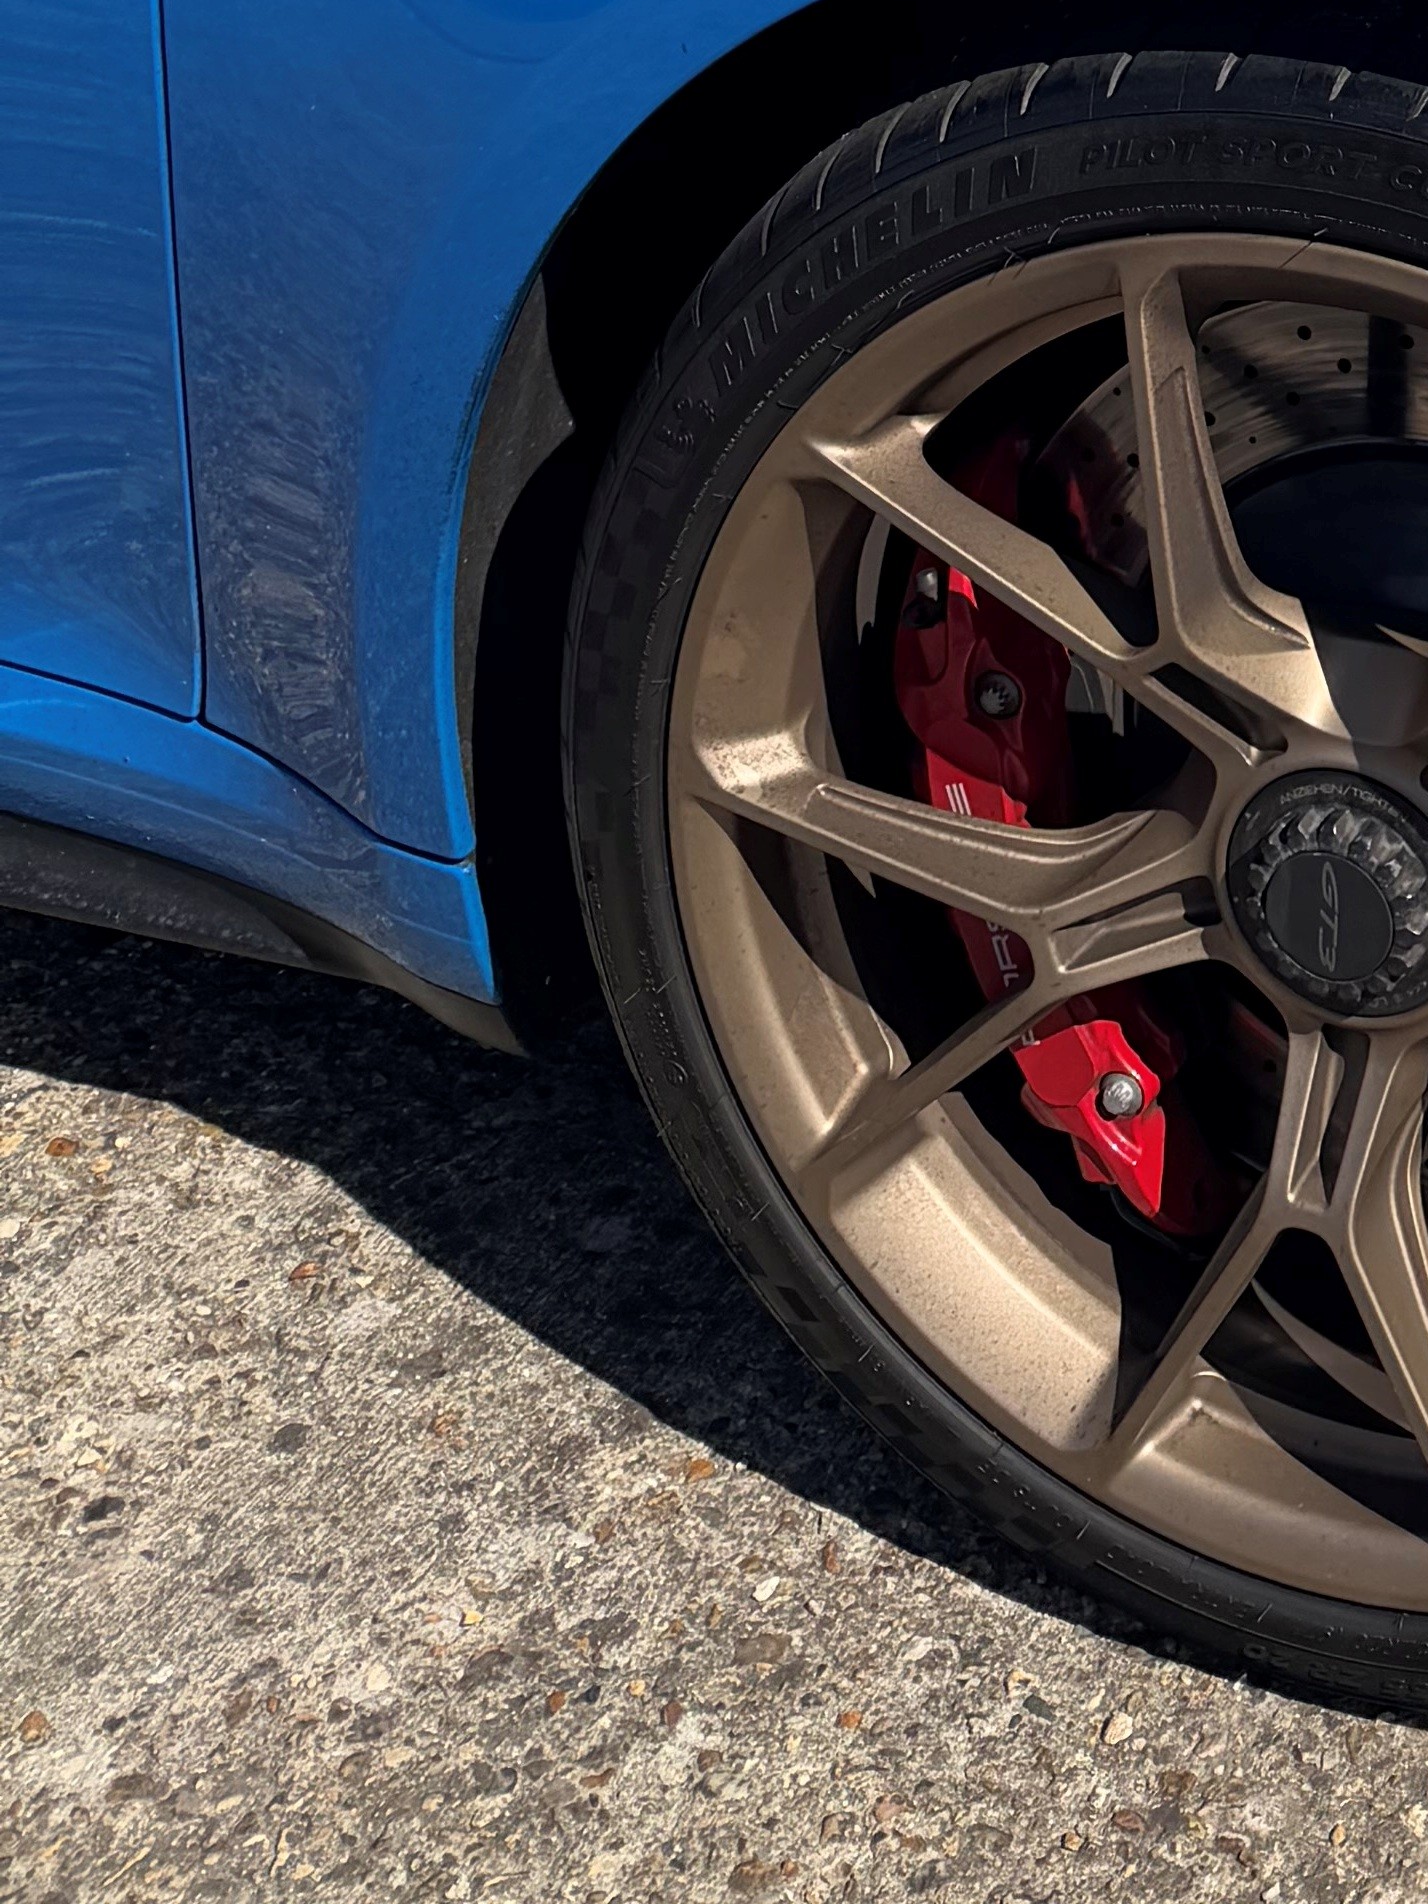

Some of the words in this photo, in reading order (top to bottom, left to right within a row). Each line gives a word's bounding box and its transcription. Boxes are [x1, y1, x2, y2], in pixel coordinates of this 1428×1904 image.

[1079, 135, 1208, 175] PILOT
[1219, 135, 1378, 180] SPORT
[709, 145, 1038, 397] MICHELIN
[1319, 861, 1339, 972] GT3
